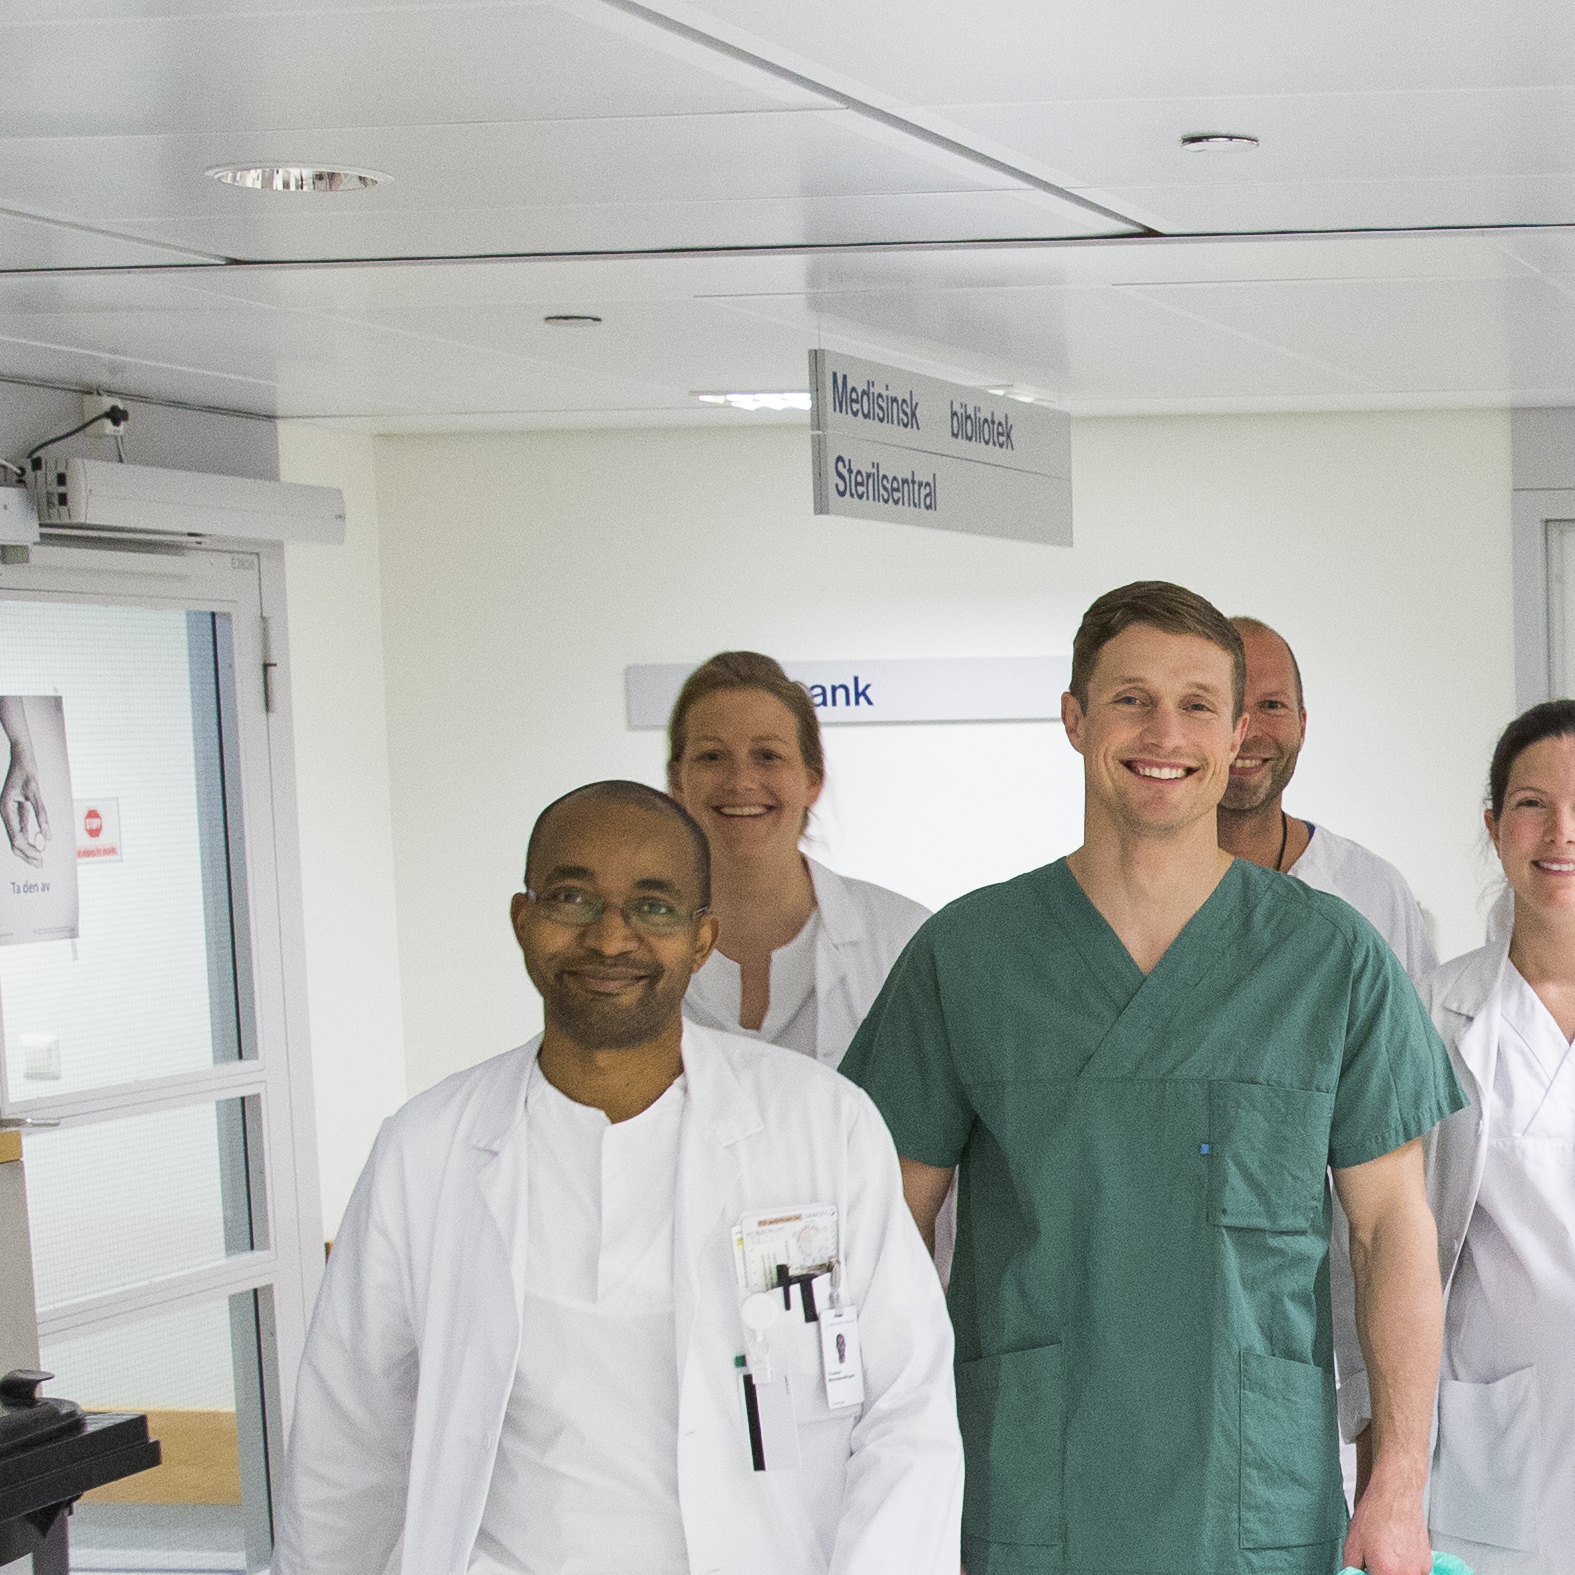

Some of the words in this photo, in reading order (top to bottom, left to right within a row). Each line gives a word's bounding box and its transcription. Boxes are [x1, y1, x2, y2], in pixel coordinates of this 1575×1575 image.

[832, 371, 920, 430] Medisinsk
[950, 400, 1014, 450] bibliotek
[835, 455, 937, 511] Sterilsentral
[10, 881, 21, 894] Ta
[23, 880, 39, 894] den
[41, 882, 51, 893] av
